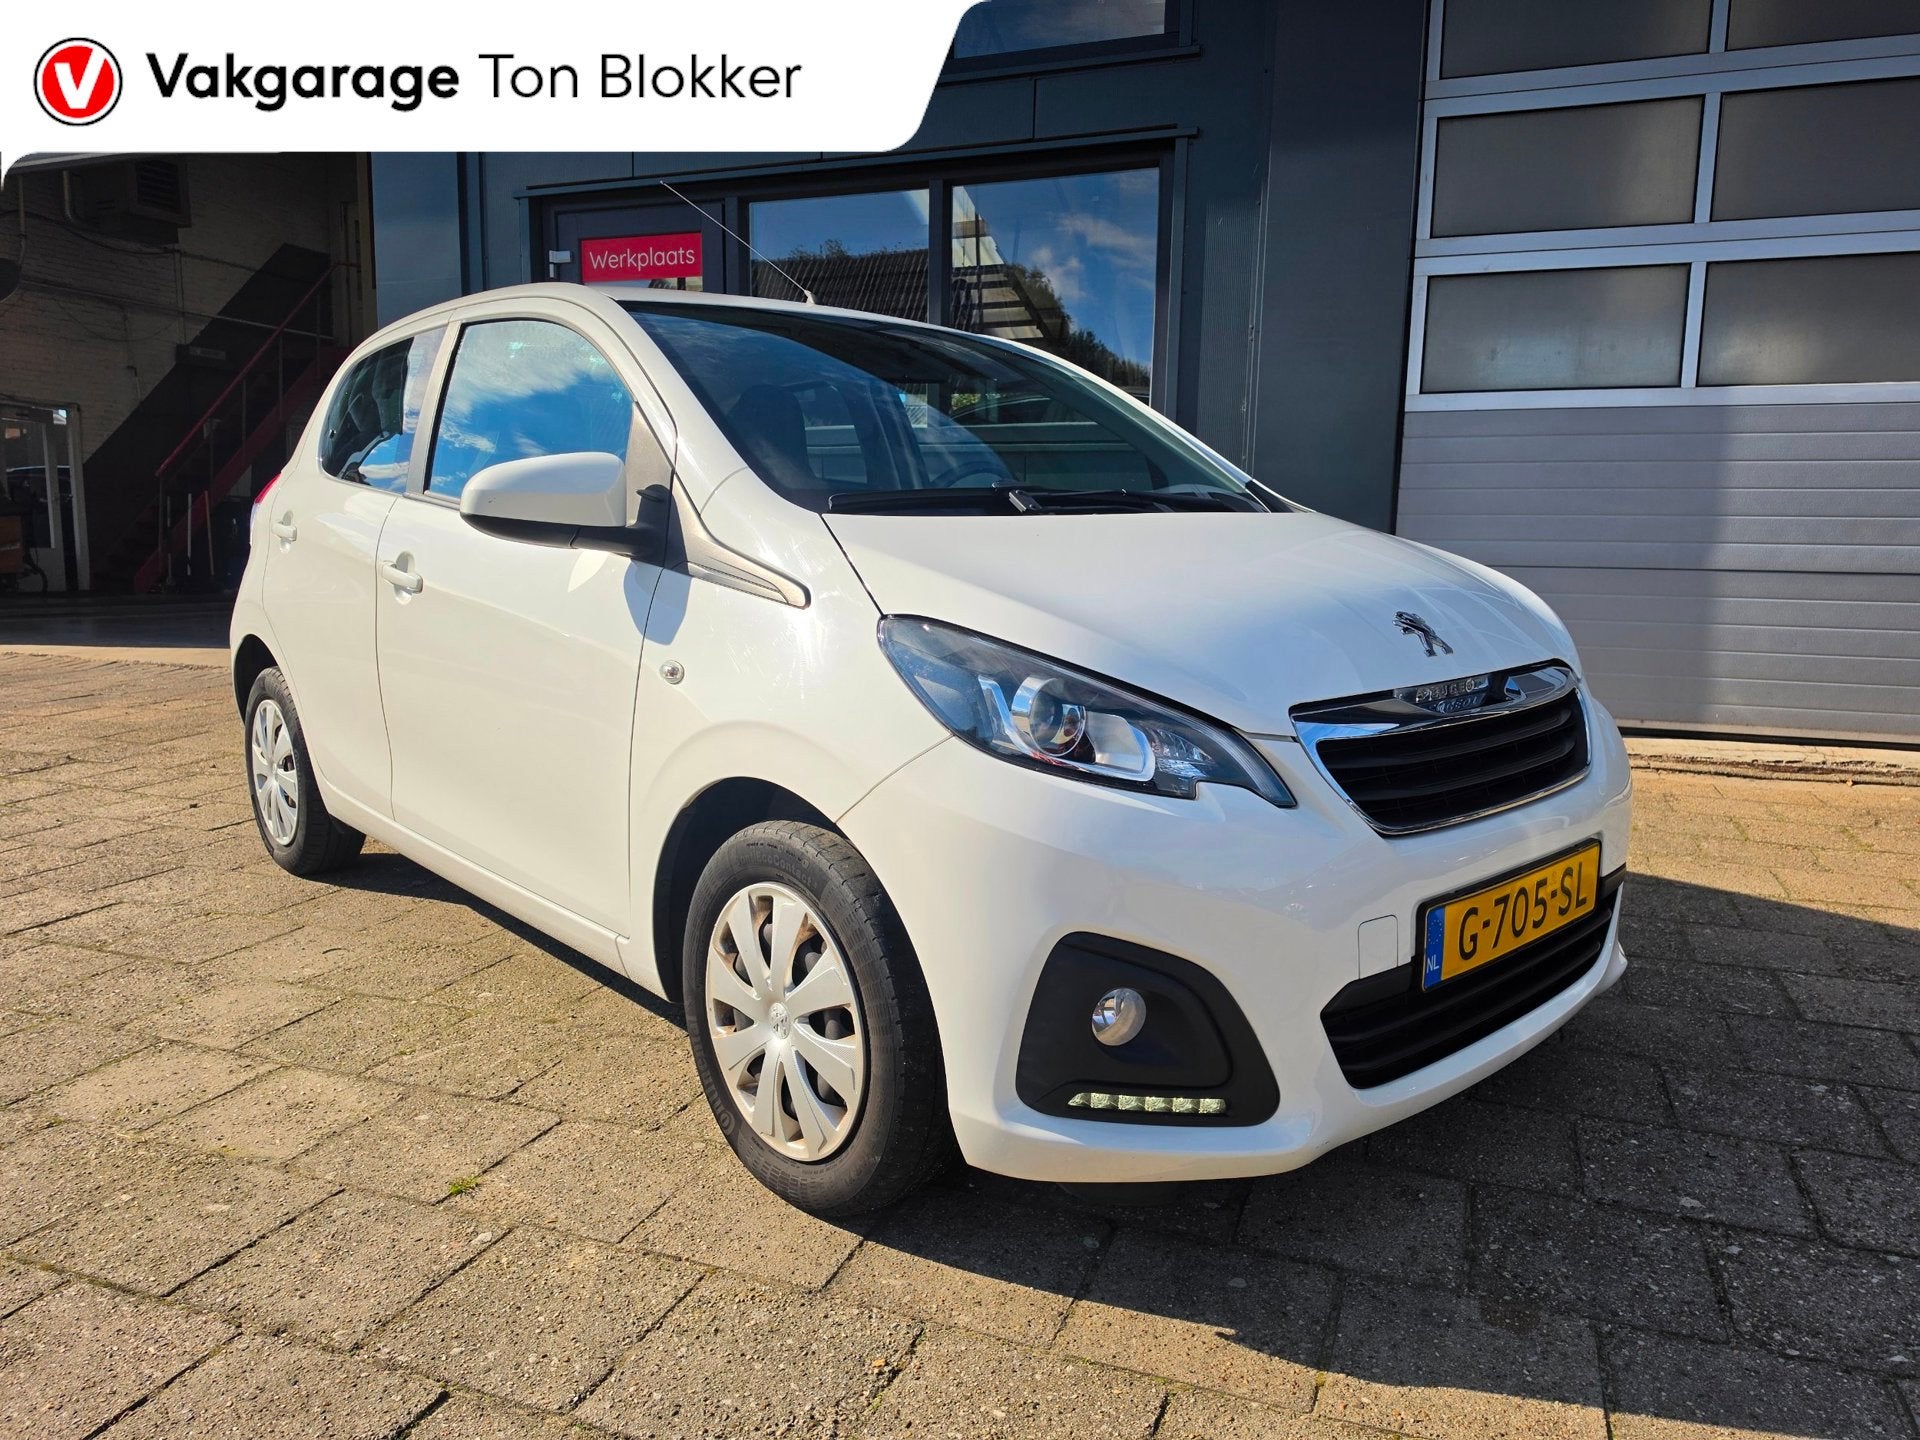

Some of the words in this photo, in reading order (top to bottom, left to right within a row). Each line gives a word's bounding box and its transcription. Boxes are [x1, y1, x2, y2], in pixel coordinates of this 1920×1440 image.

[589, 246, 696, 272] Werkplaats
[1458, 861, 1588, 961] G-705-SL
[1426, 955, 1440, 974] NL
